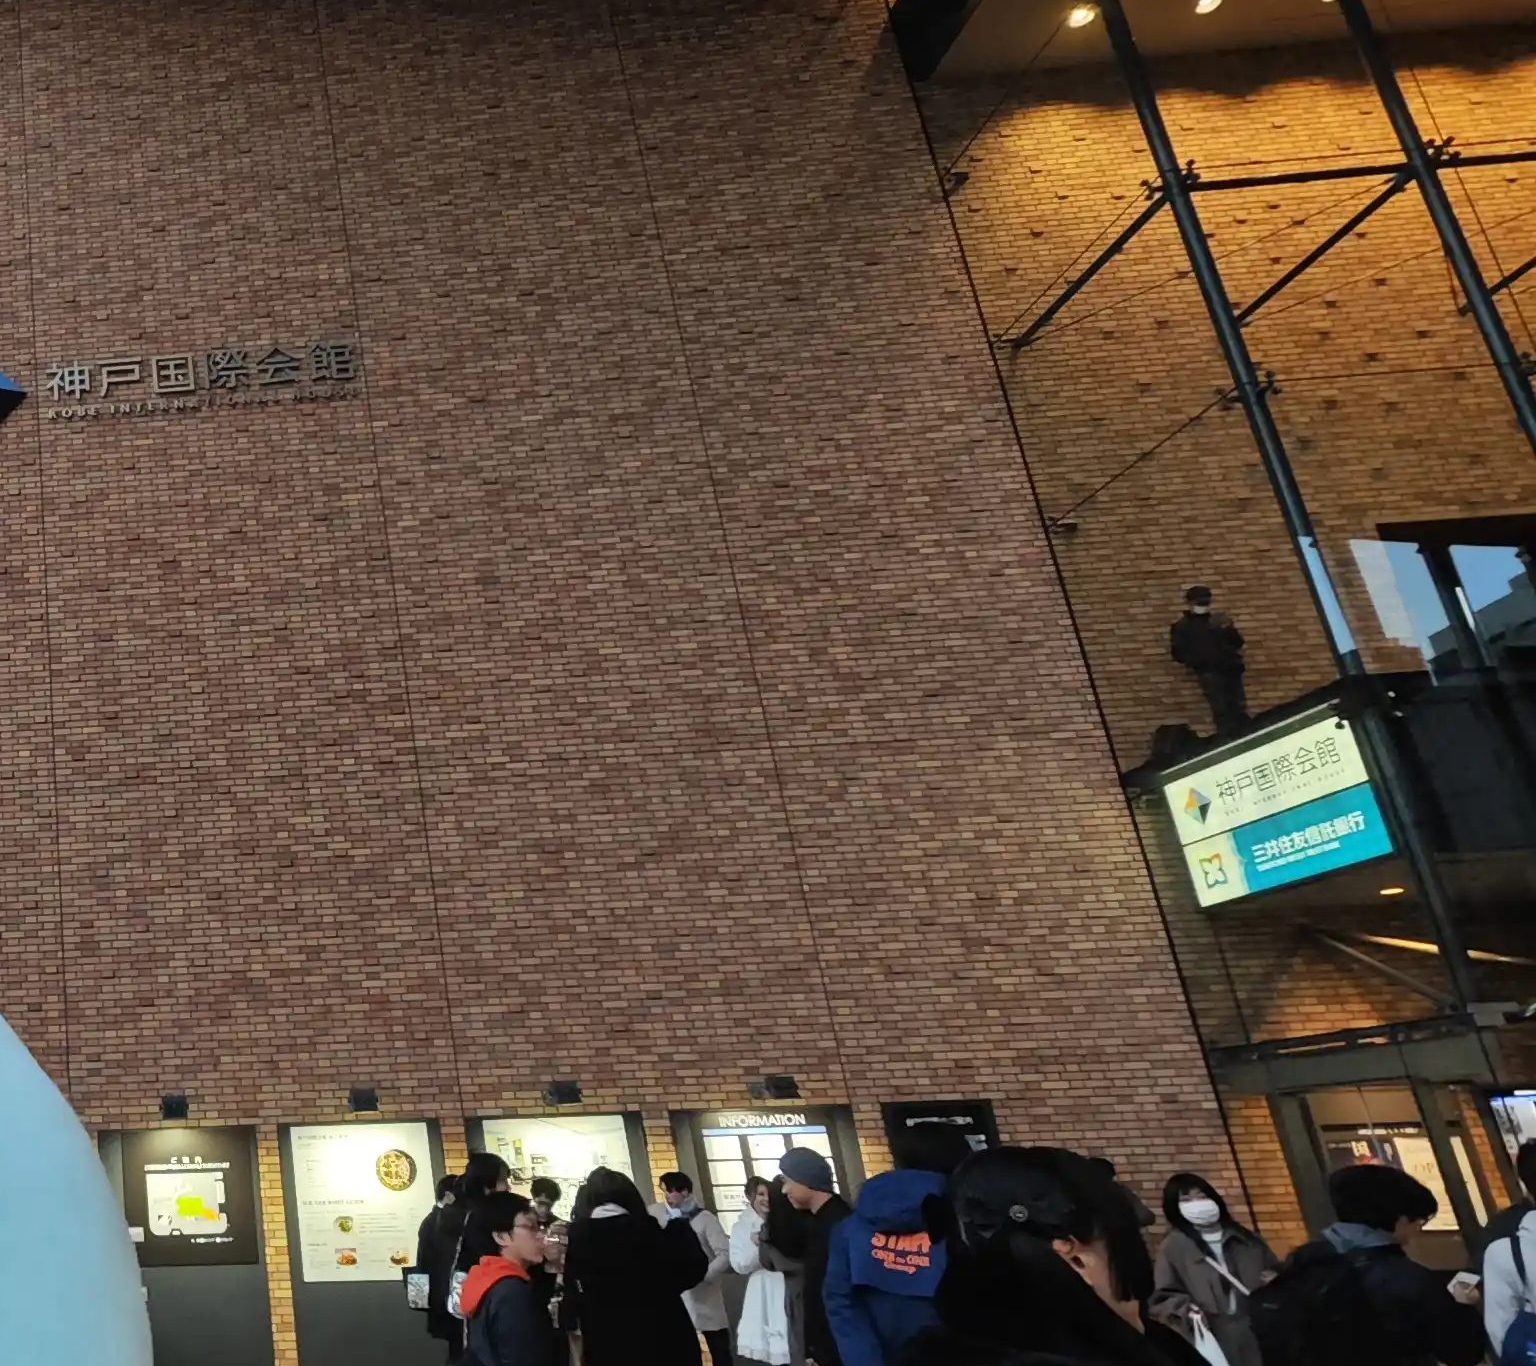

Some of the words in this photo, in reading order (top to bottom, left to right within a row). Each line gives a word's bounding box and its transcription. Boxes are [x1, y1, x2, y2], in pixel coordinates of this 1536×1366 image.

[45, 340, 358, 402] 神戸国際会館
[1215, 736, 1342, 806] 神戸国際会館
[1251, 810, 1366, 864] 三井住友信託銀行
[718, 1113, 806, 1128] INFORMATION
